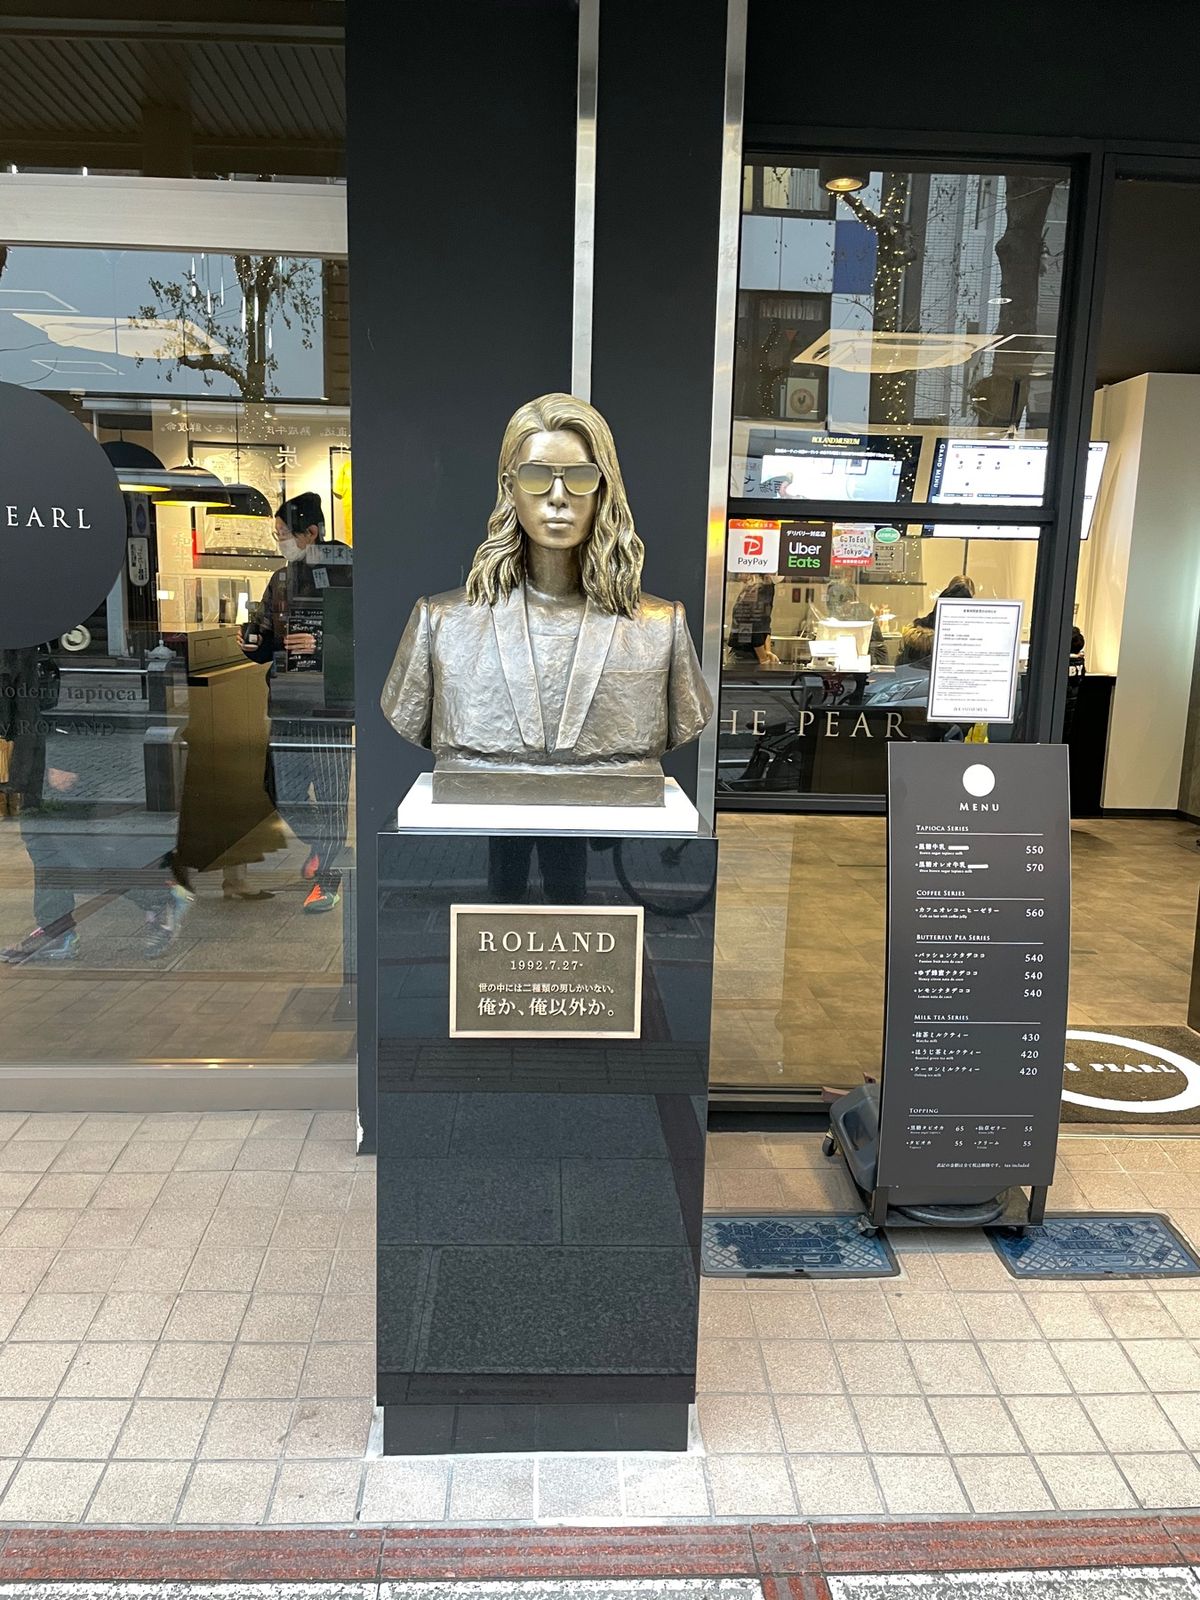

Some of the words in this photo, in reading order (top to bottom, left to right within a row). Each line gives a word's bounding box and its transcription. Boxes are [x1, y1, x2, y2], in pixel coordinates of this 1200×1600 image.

[6, 505, 91, 529] EARL
[789, 542, 822, 555] Uber
[844, 548, 862, 556] Tokyo
[737, 557, 768, 567] PayPay
[788, 555, 821, 568] Eats
[66, 684, 137, 704] tapioca
[797, 710, 908, 738] PEAR
[960, 802, 1000, 812] MENU
[1025, 845, 1044, 855] 550
[1026, 863, 1044, 872] 570
[1025, 908, 1044, 918] 560
[478, 931, 616, 953] ROLAND
[1024, 953, 1044, 963] 540
[1024, 971, 1043, 980] 540
[478, 983, 614, 994] 世の中には二種類の男しかいない。
[1023, 989, 1042, 998] 540
[477, 997, 614, 1016] 俺か、俺以外か。
[1021, 1033, 1040, 1042] 430
[1020, 1050, 1039, 1059] 420
[1019, 1067, 1038, 1076] 420
[1088, 1062, 1177, 1073] PEARL
